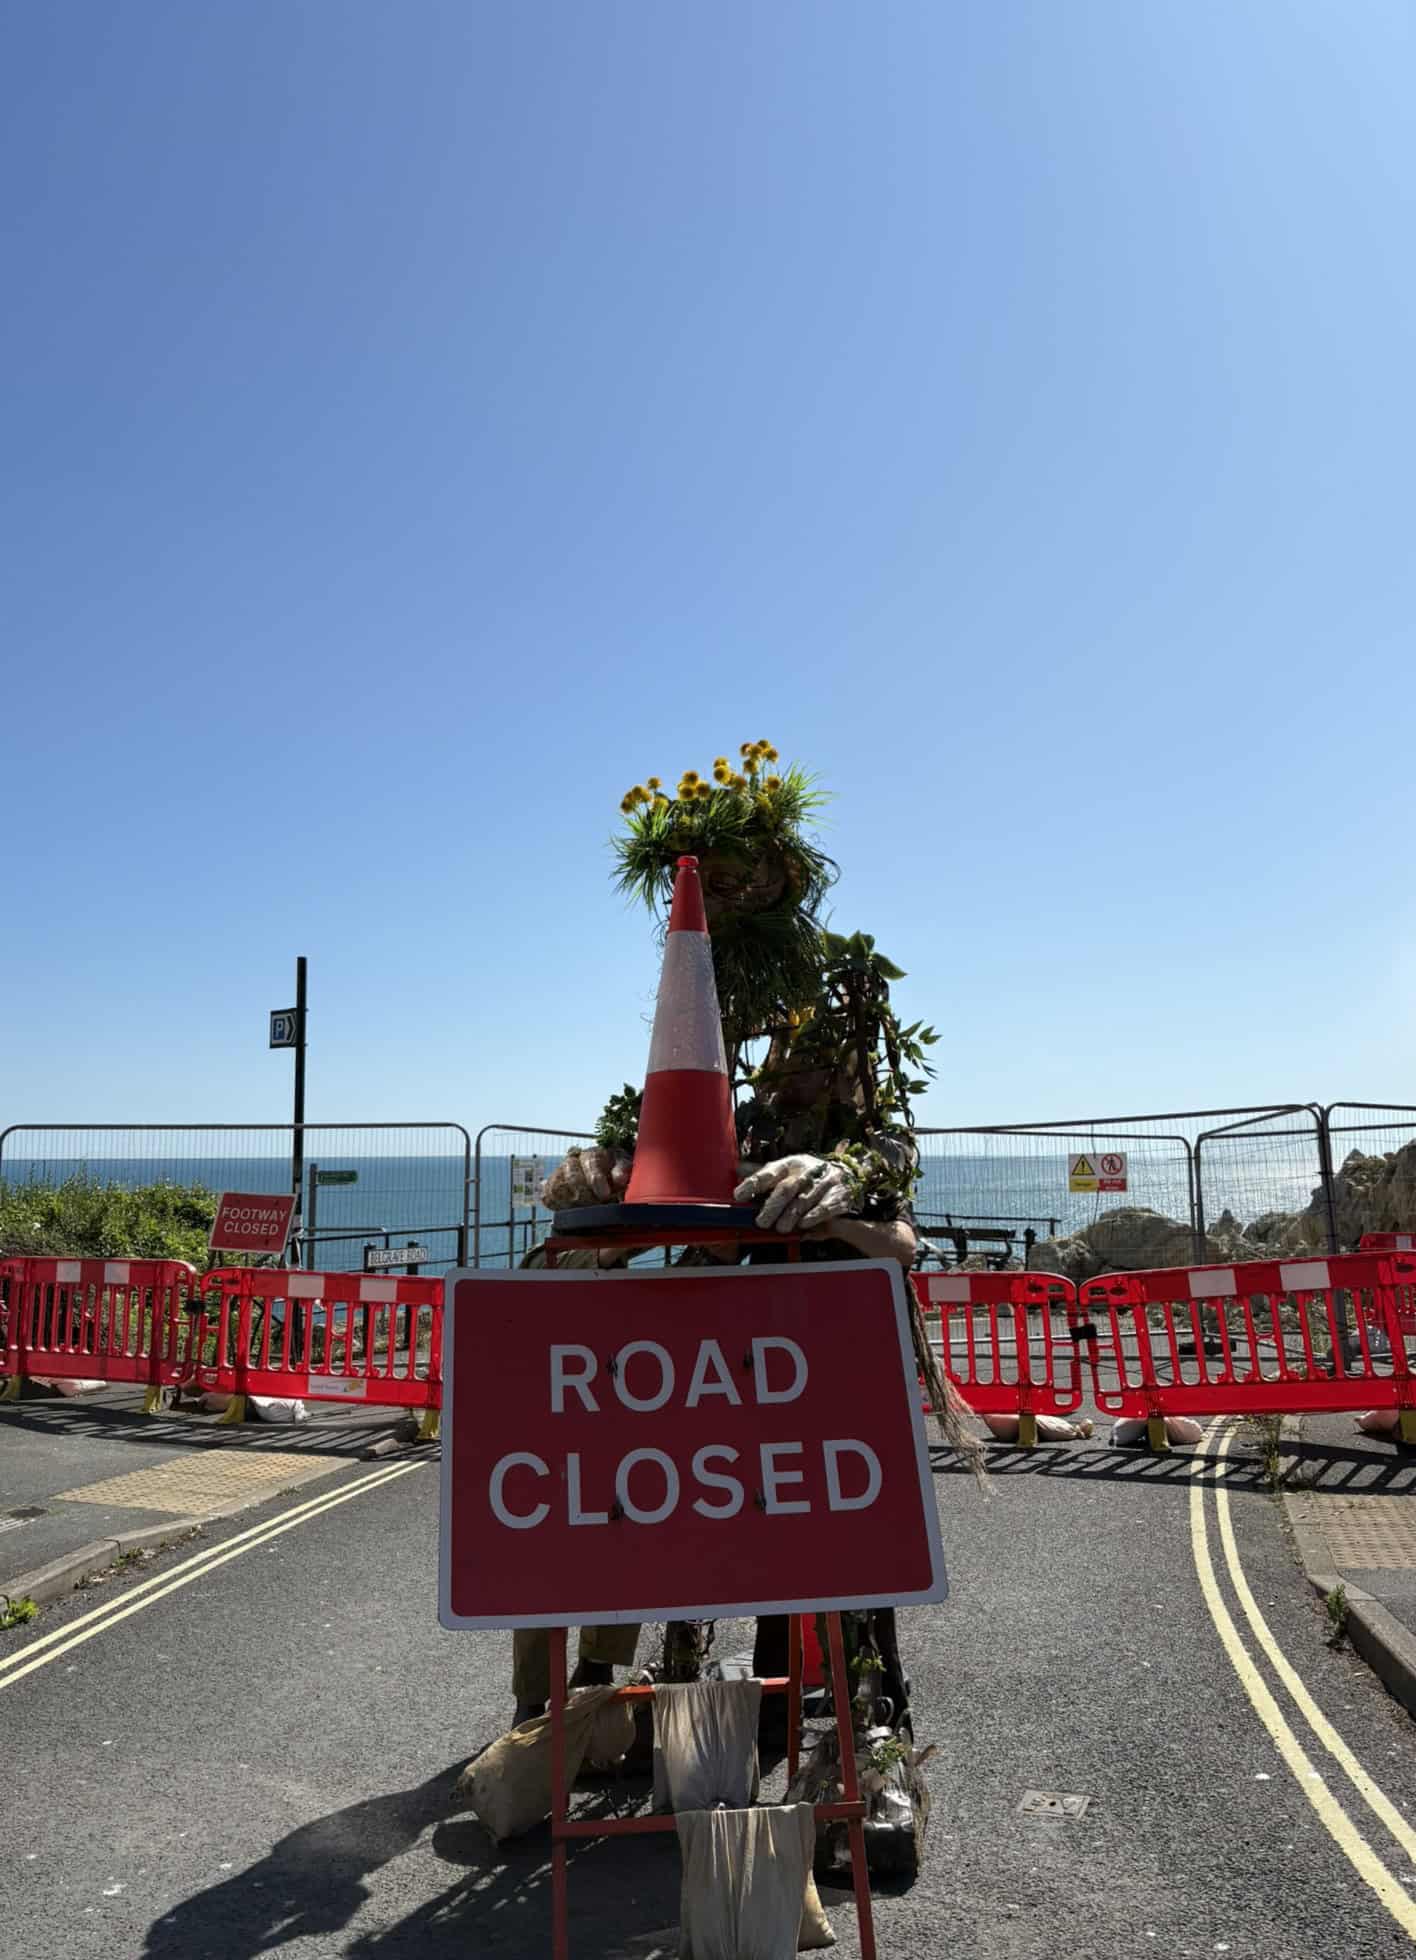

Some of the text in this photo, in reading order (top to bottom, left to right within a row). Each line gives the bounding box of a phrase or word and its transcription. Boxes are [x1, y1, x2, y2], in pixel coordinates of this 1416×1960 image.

[276, 1020, 283, 1038] P
[222, 1207, 287, 1222] FOOTWAY
[224, 1221, 279, 1236] CLOSED
[407, 1248, 427, 1262] ROAD
[550, 1336, 809, 1413] ROAD
[489, 1438, 882, 1529] CLOSED
